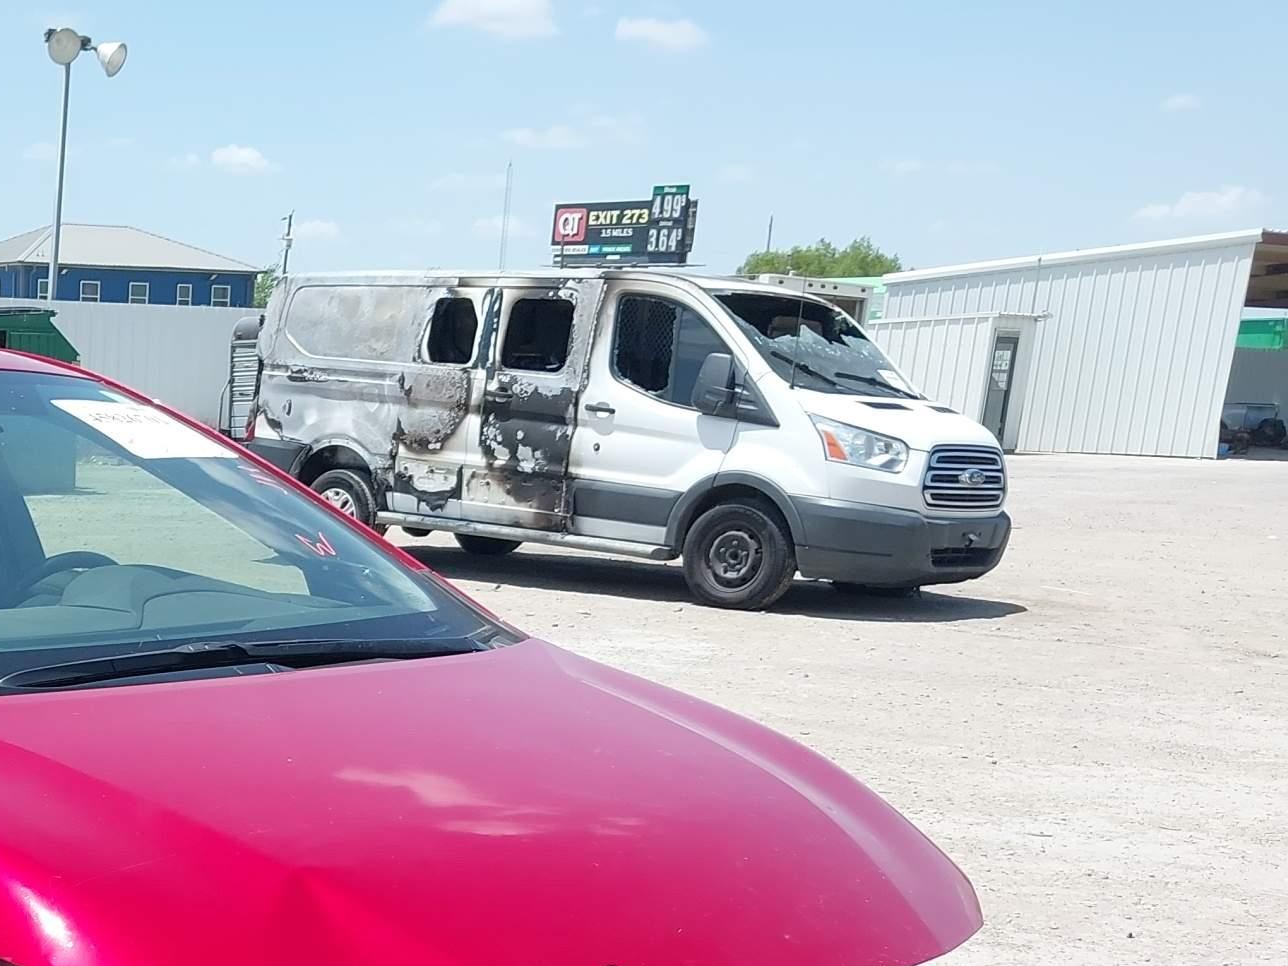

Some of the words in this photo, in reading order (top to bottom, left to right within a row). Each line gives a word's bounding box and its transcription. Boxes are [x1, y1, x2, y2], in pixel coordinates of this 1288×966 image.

[558, 213, 584, 237] QT
[588, 210, 621, 225] EXIT
[621, 208, 649, 224] 273
